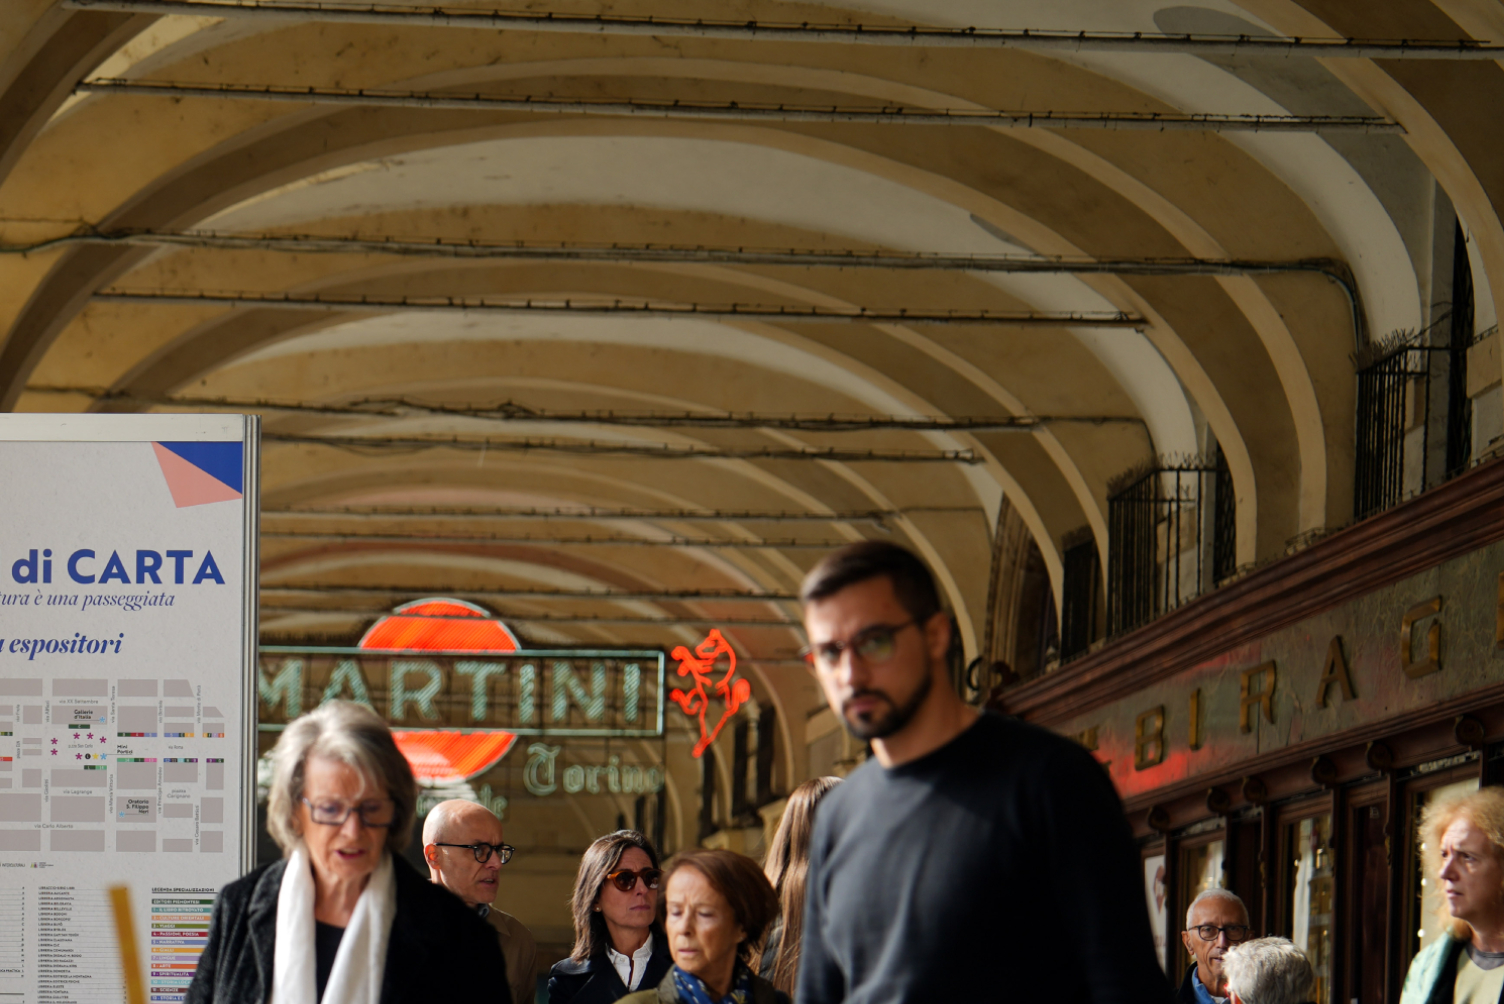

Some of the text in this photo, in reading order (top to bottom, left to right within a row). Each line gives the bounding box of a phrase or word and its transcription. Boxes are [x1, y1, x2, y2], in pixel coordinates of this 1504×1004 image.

[12, 548, 52, 584] di
[67, 549, 226, 585] CARTA
[34, 588, 43, 606] è
[47, 593, 78, 606] una
[81, 590, 175, 612] passeggiata
[8, 632, 124, 661] espositori
[1134, 570, 1504, 773] BIRAG
[259, 657, 642, 724] MARTINI
